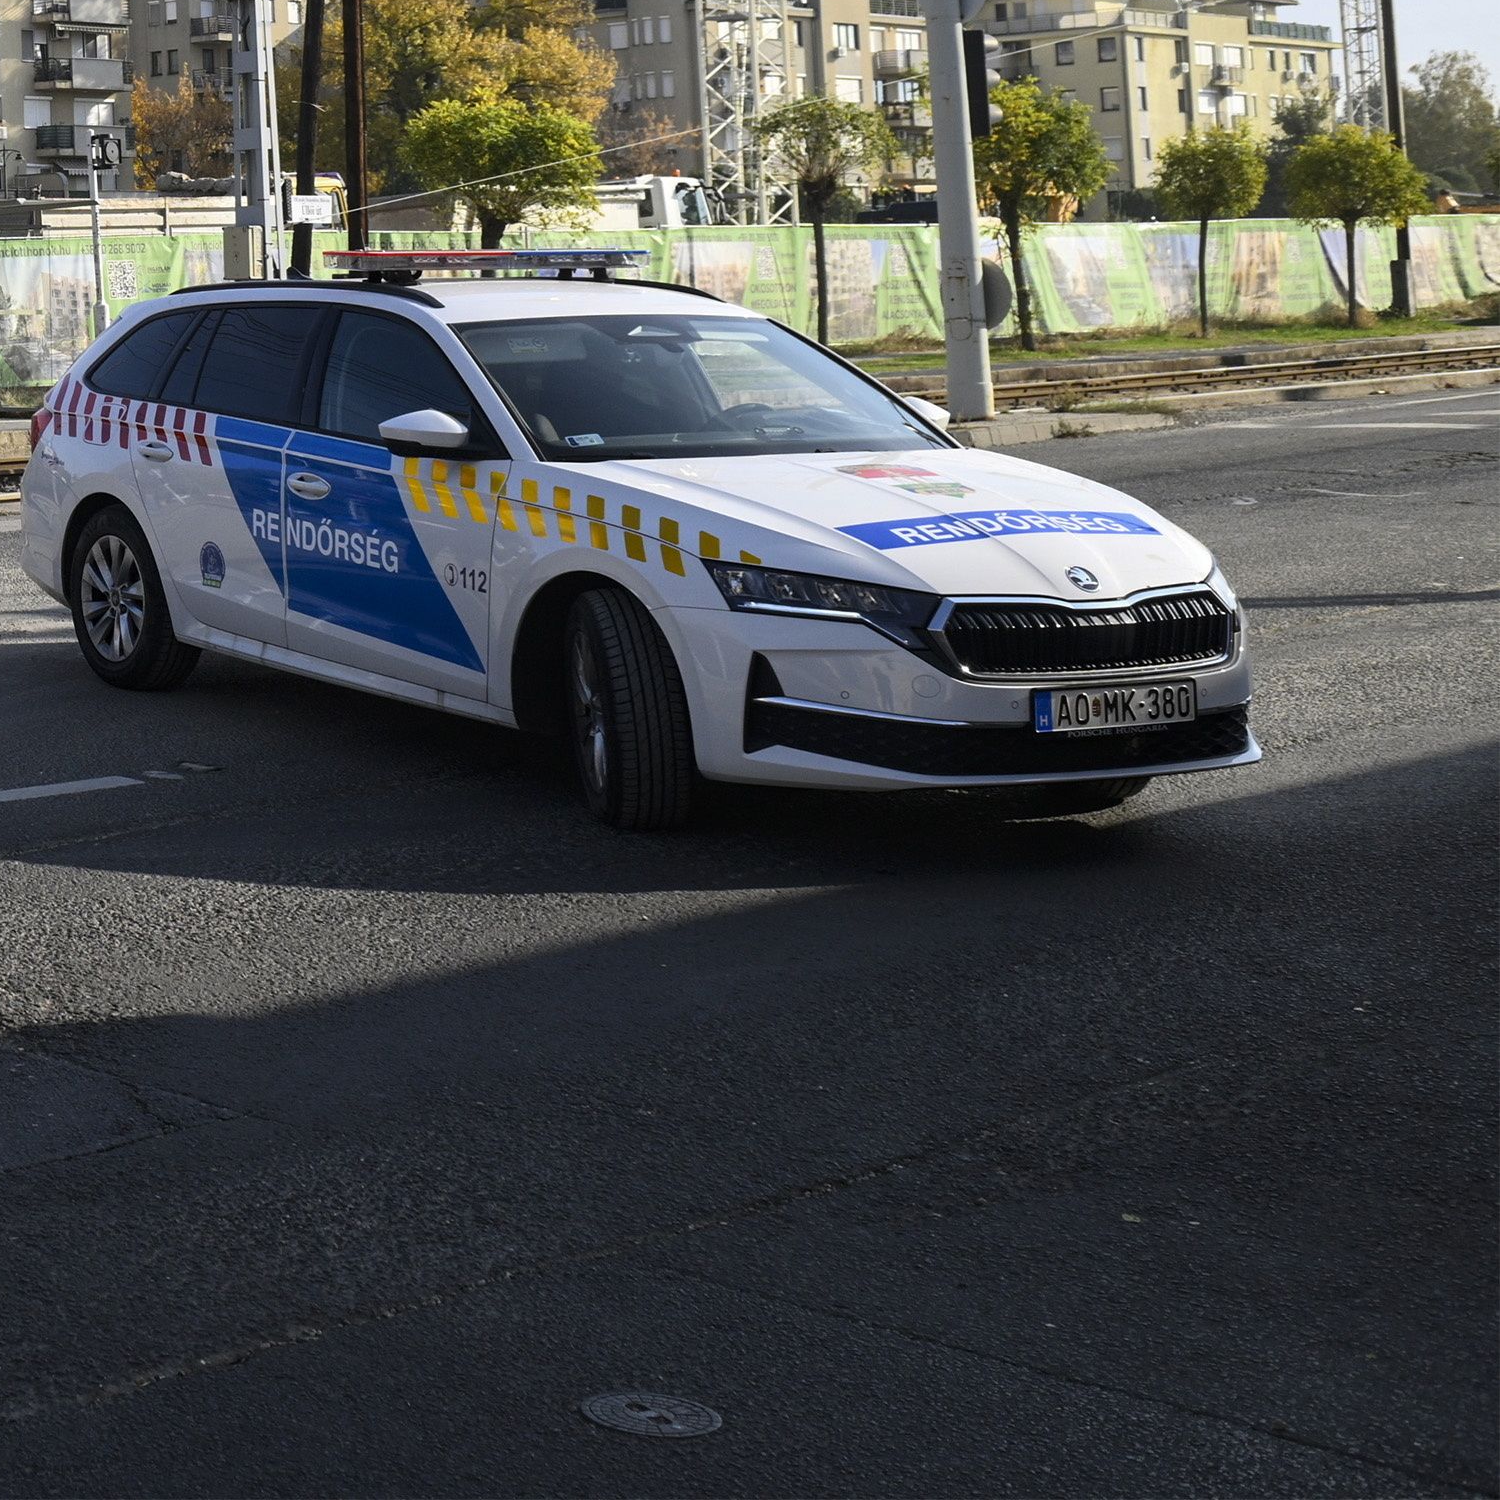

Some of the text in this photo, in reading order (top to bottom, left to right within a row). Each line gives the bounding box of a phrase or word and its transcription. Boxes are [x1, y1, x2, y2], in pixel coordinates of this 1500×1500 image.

[252, 508, 399, 574] RENDŐRSÉG
[889, 512, 1128, 545] RENDŐRSÉG
[459, 567, 487, 593] 112
[1039, 715, 1048, 726] H
[1067, 724, 1168, 738] PORSCHE HUNGARIA
